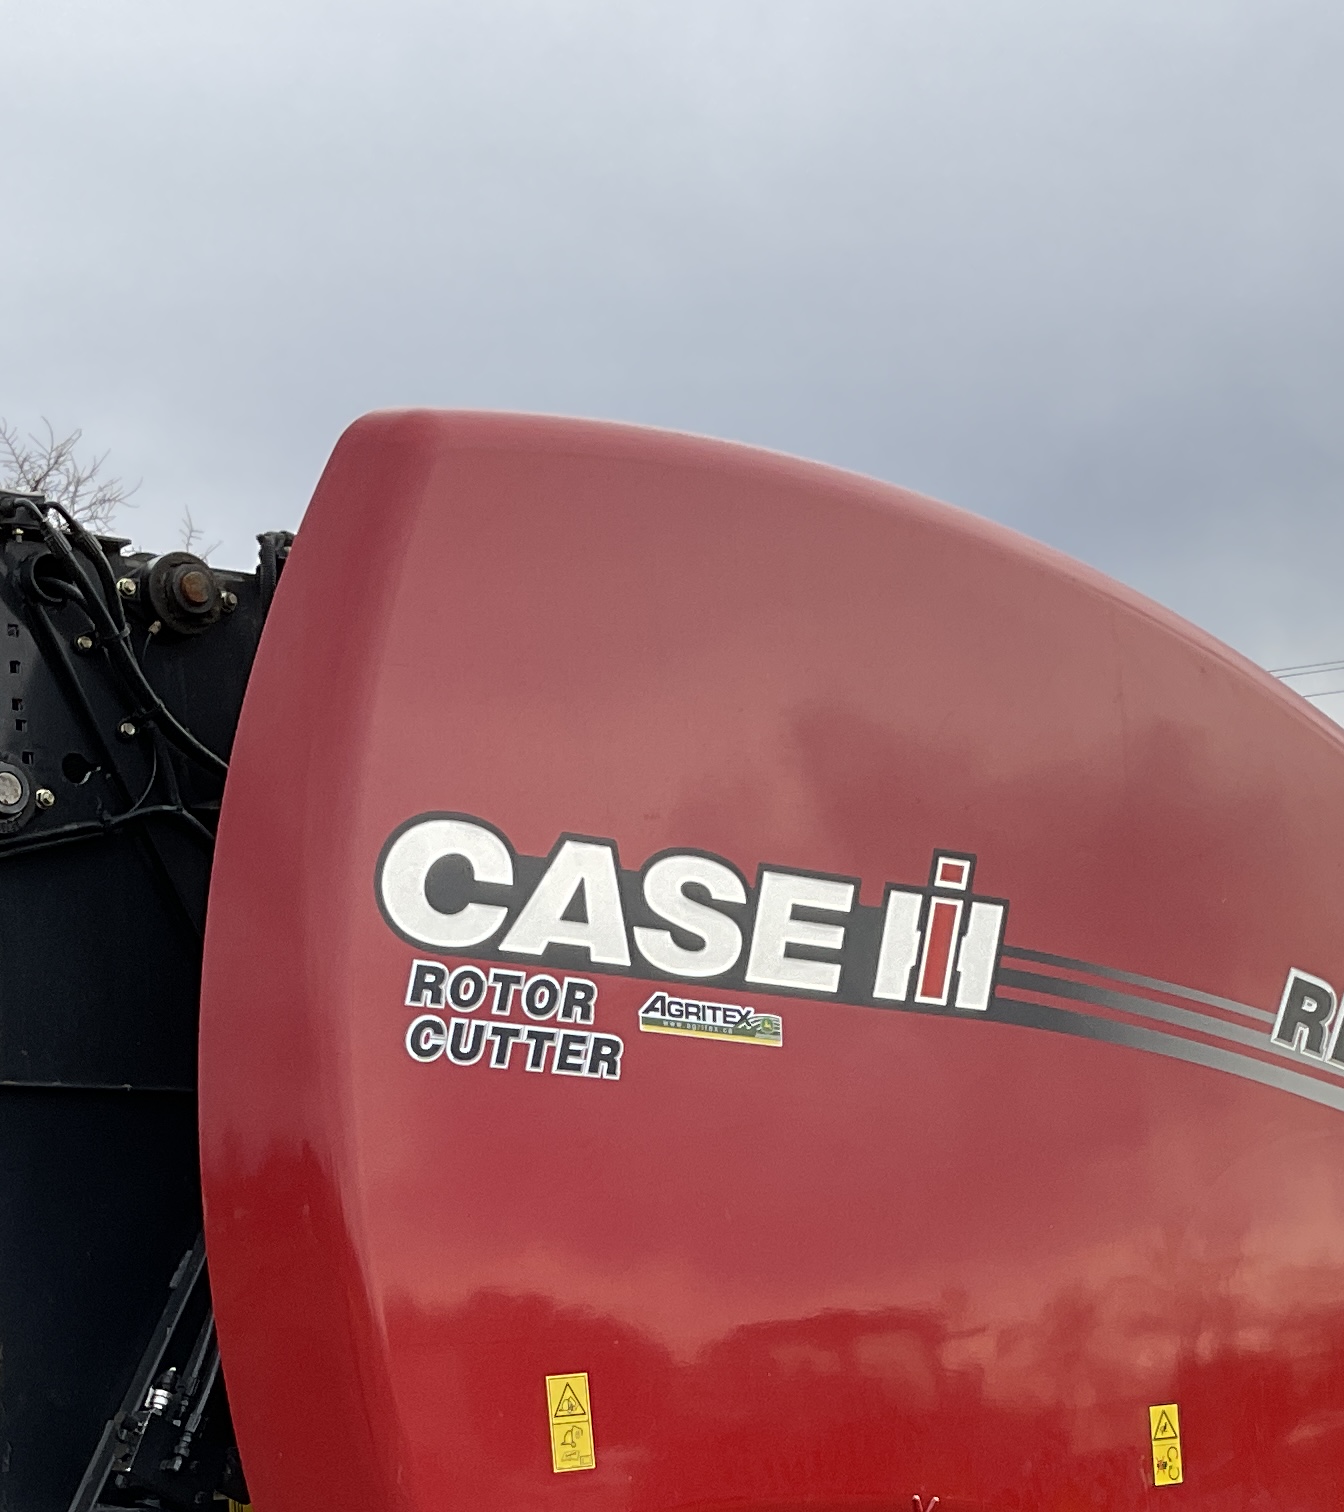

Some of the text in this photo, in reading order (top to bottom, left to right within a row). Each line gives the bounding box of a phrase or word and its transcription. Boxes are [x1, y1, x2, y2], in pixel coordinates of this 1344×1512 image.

[381, 819, 856, 993] CASE
[404, 959, 598, 1025] ROTOR
[641, 995, 753, 1028] AGRITEX
[405, 1014, 625, 1080] CUTTER
